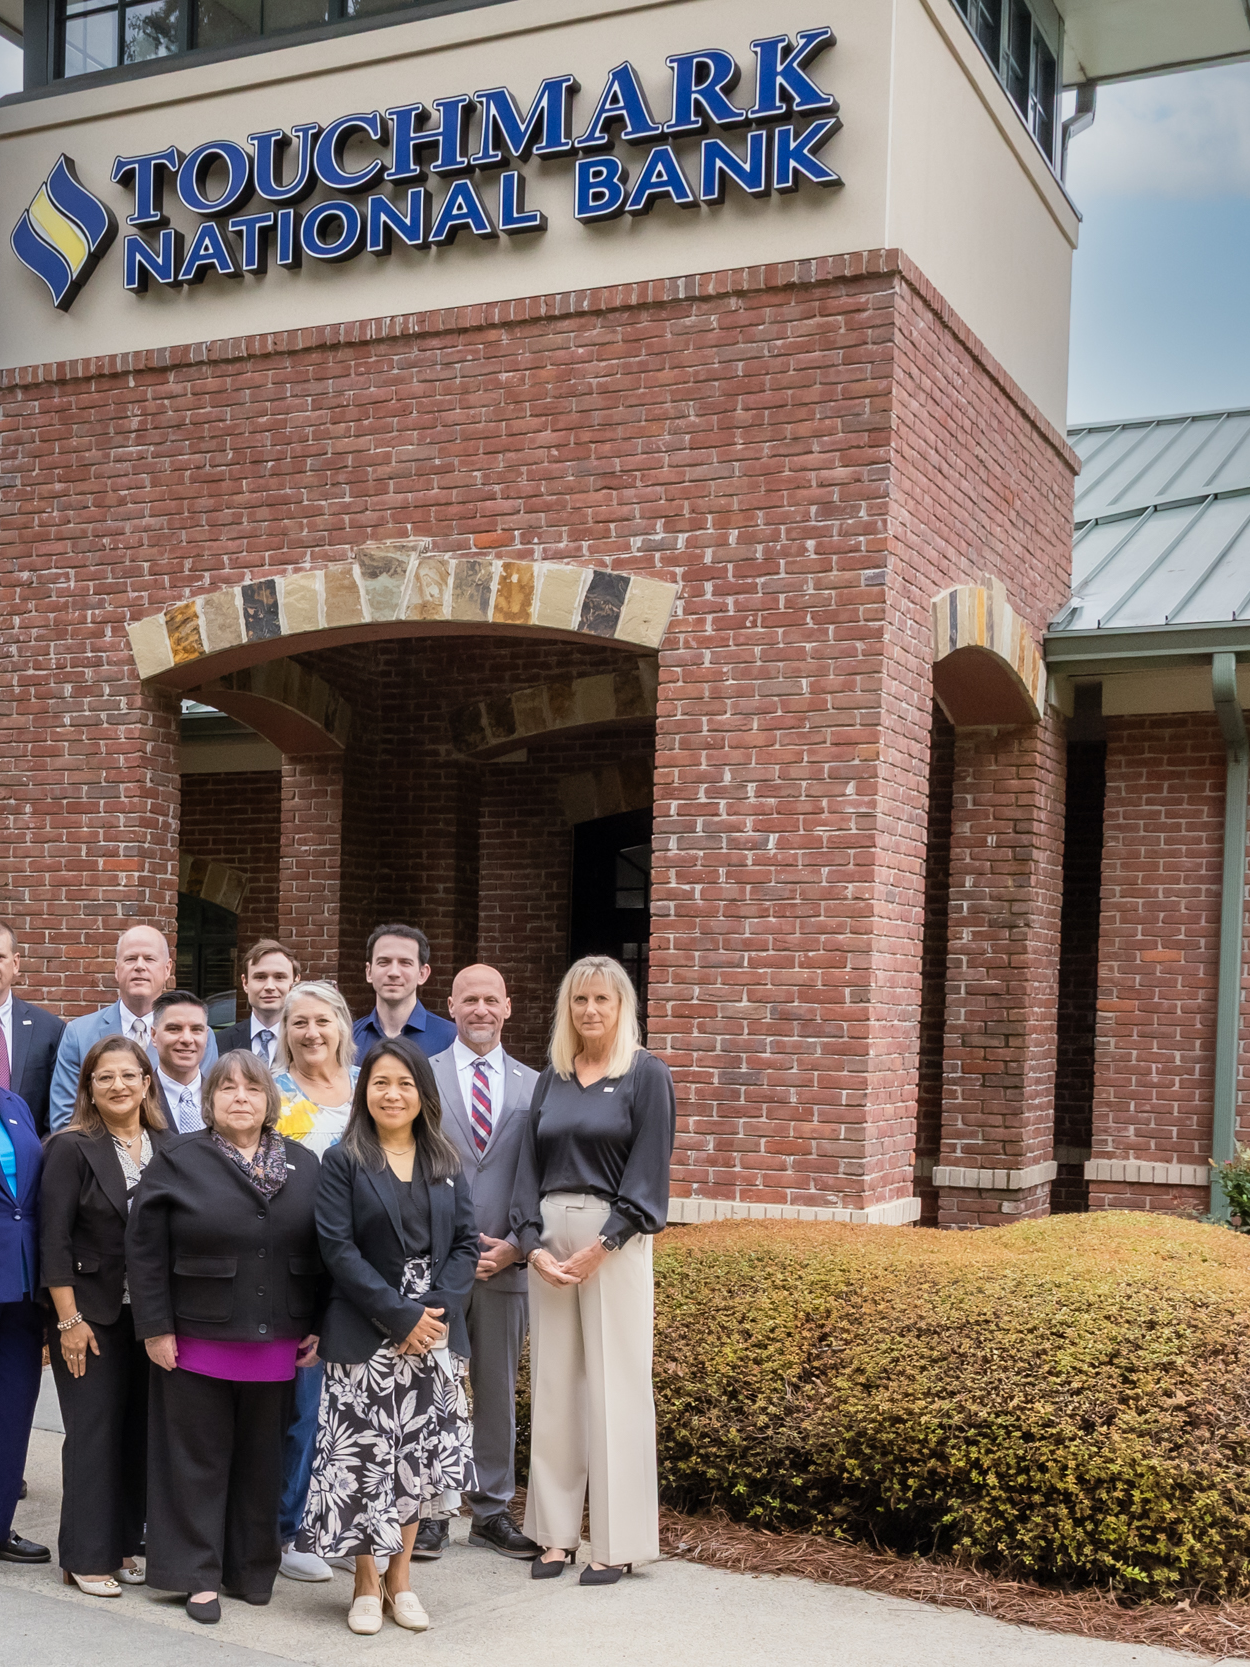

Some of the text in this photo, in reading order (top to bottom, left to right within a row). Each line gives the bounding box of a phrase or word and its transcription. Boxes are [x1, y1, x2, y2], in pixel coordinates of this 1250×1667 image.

[111, 26, 838, 228] TOUCHMARK
[123, 116, 842, 290] NATIONAL BANK
